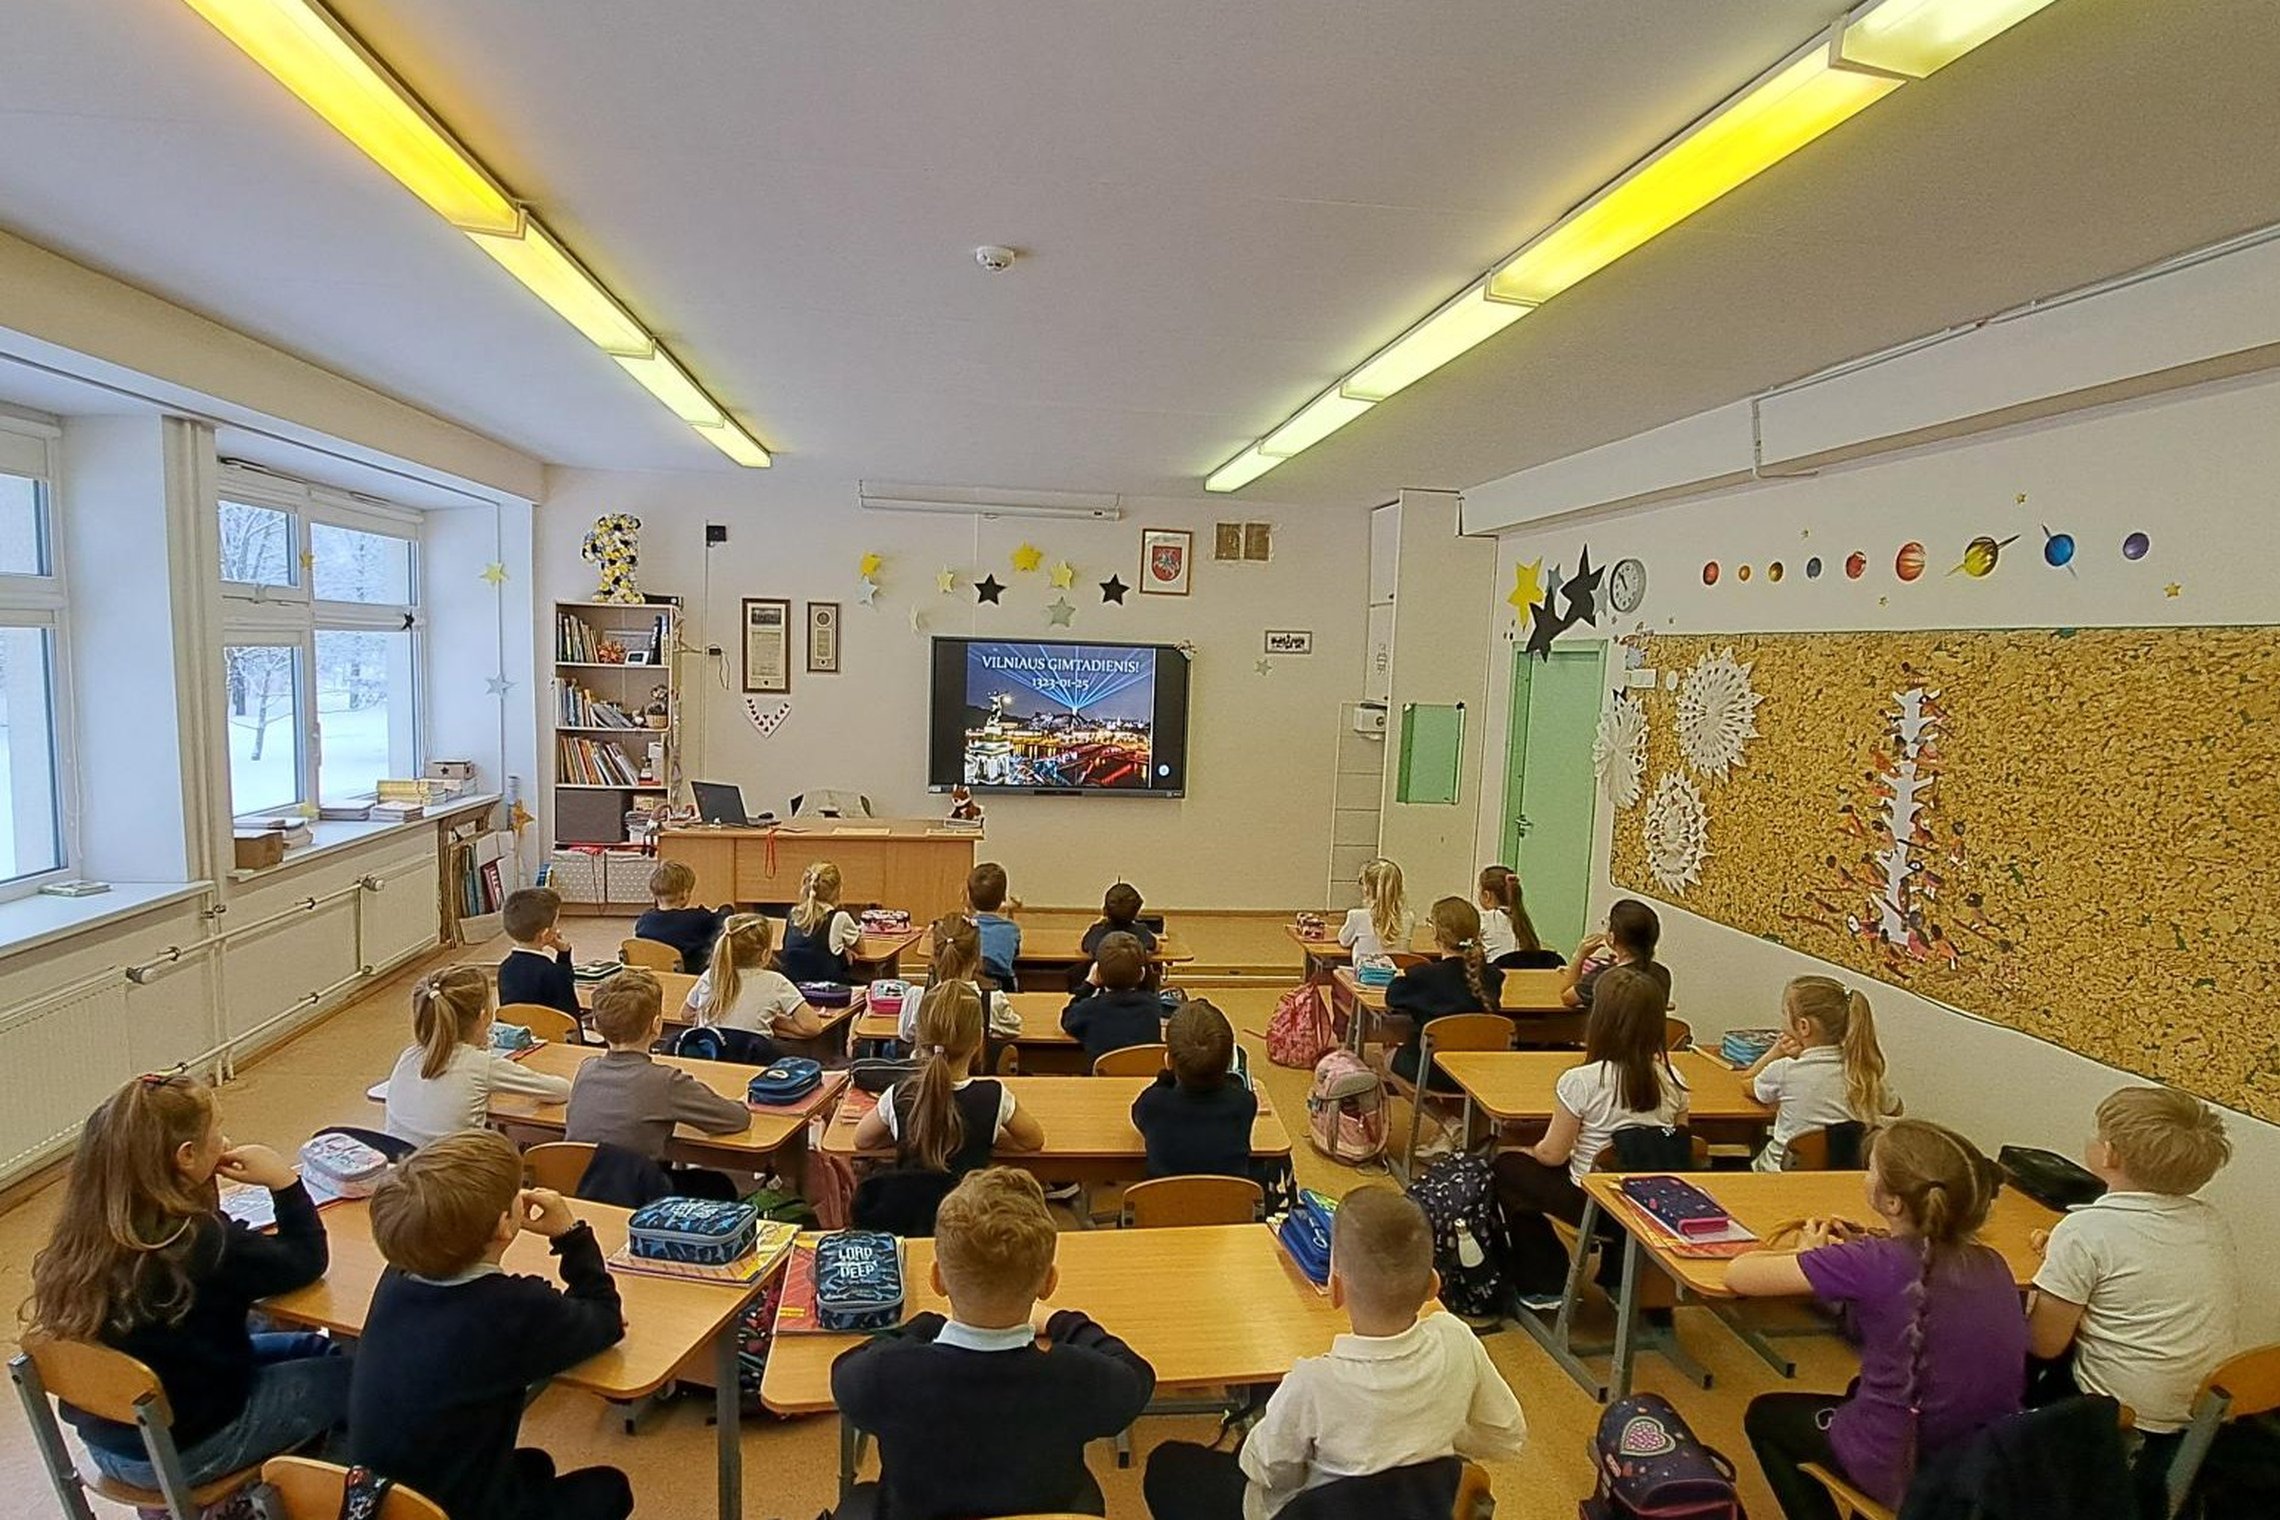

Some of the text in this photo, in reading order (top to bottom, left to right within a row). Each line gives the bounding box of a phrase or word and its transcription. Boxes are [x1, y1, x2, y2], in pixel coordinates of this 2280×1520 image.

[982, 656, 1140, 673] VILNIAUS GIMTADIENIS!
[1032, 678, 1089, 690] 1323-01-25
[838, 1247, 873, 1260] LORD
[840, 1264, 875, 1279] DEEP
